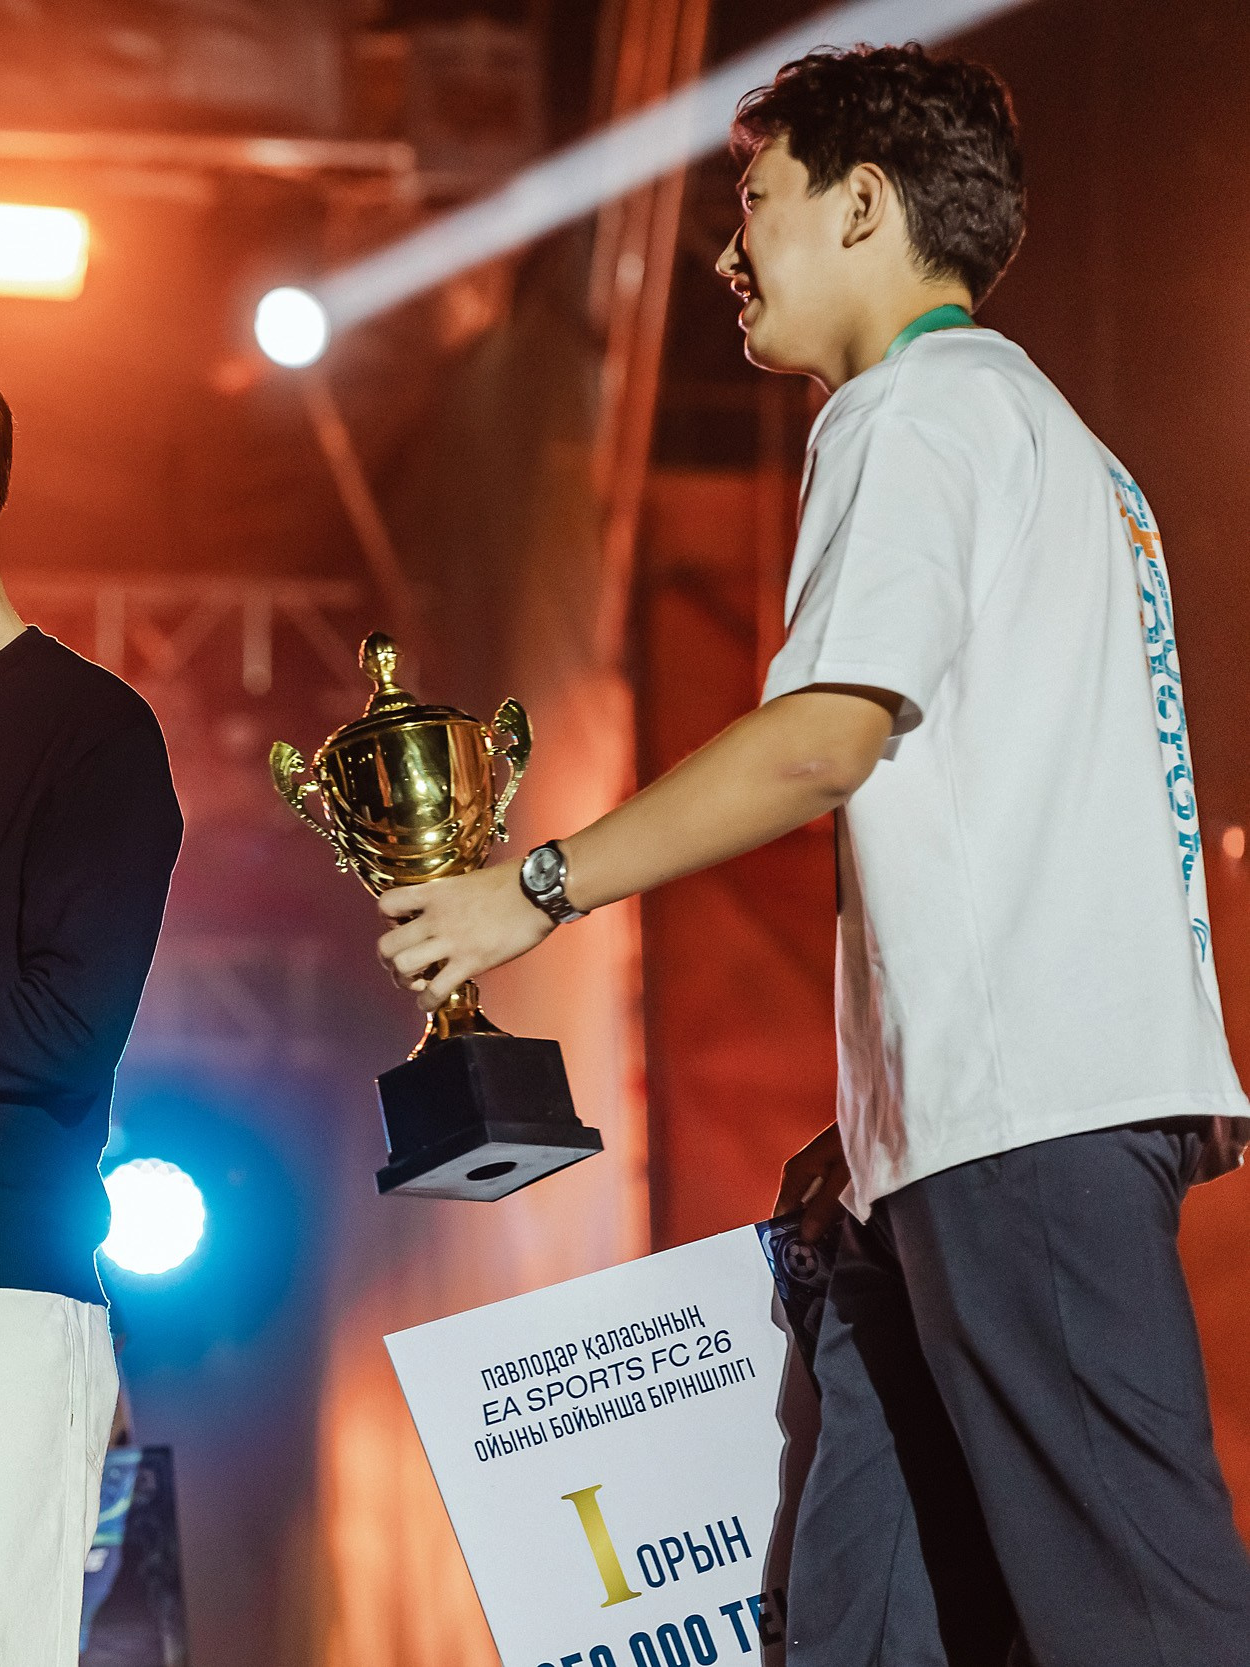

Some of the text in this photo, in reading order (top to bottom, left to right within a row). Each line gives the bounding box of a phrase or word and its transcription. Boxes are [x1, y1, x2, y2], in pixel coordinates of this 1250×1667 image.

[483, 1329, 732, 1426] EA SPORTS FC 26
[474, 1422, 548, 1462] ОЙЫНЫ
[636, 1516, 753, 1589] ОРЫН
